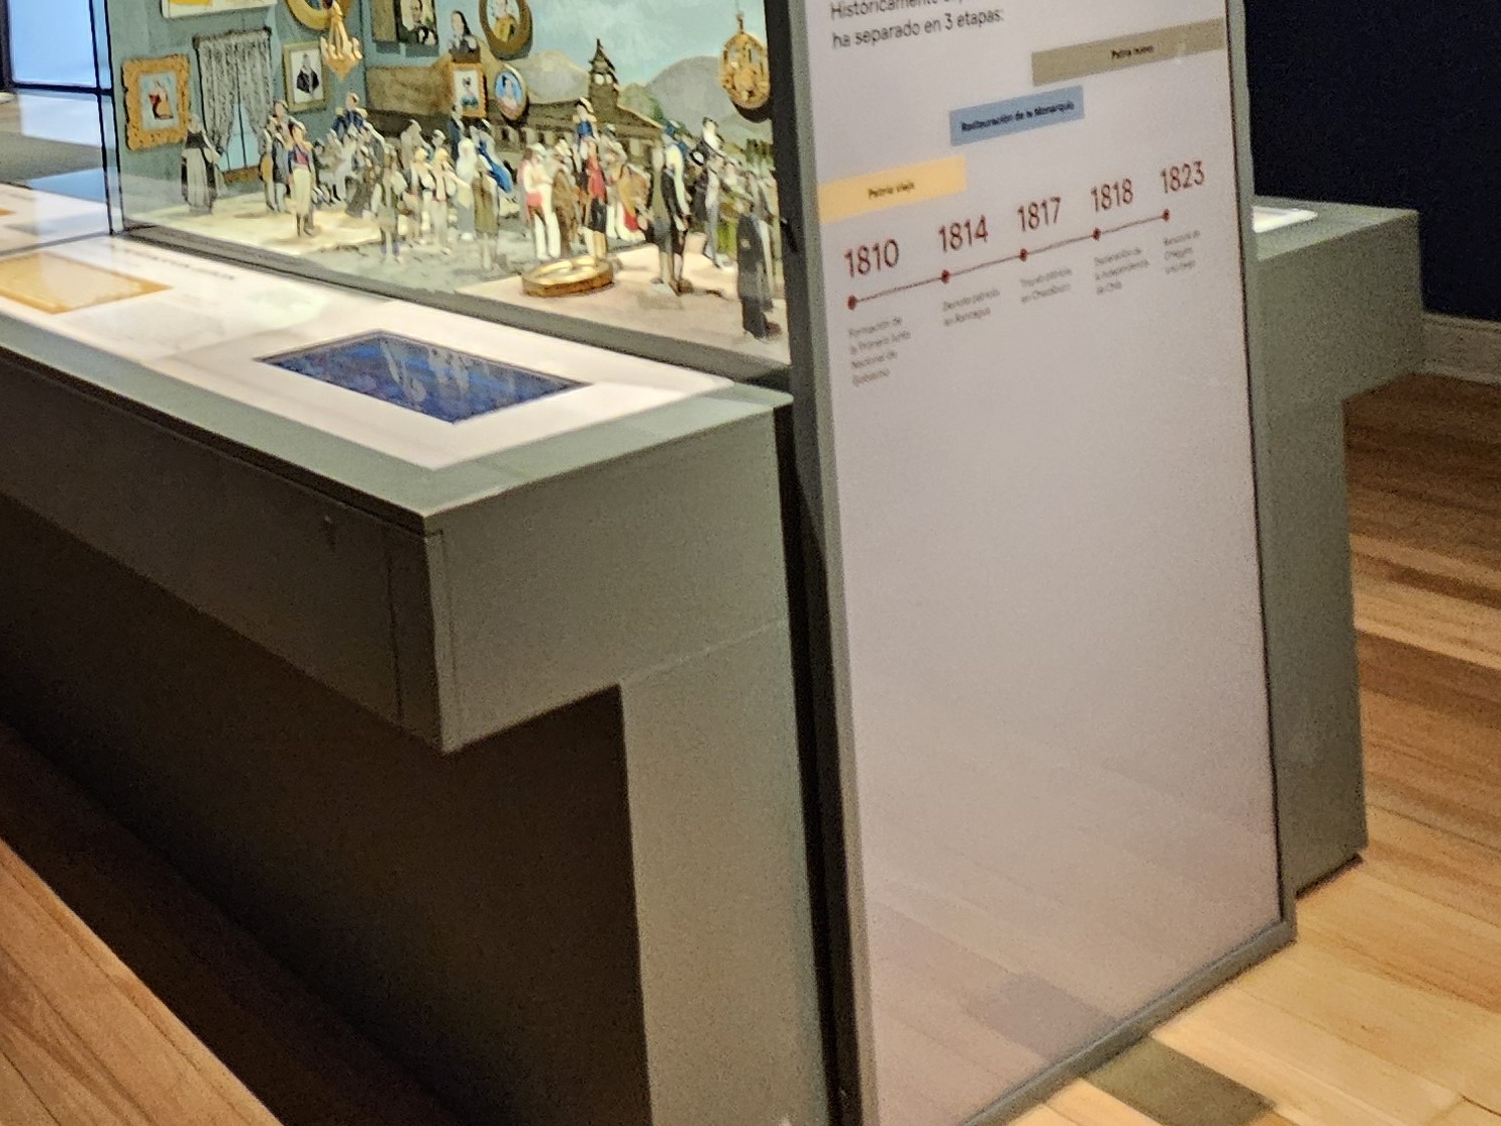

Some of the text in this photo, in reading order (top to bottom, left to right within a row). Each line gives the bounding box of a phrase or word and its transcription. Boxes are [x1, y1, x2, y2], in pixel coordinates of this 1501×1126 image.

[832, 32, 851, 49] ha
[855, 20, 920, 46] separado
[924, 19, 942, 34] en
[945, 13, 952, 31] 3
[844, 160, 1204, 277] 1810 1814 1817 1818 1823
